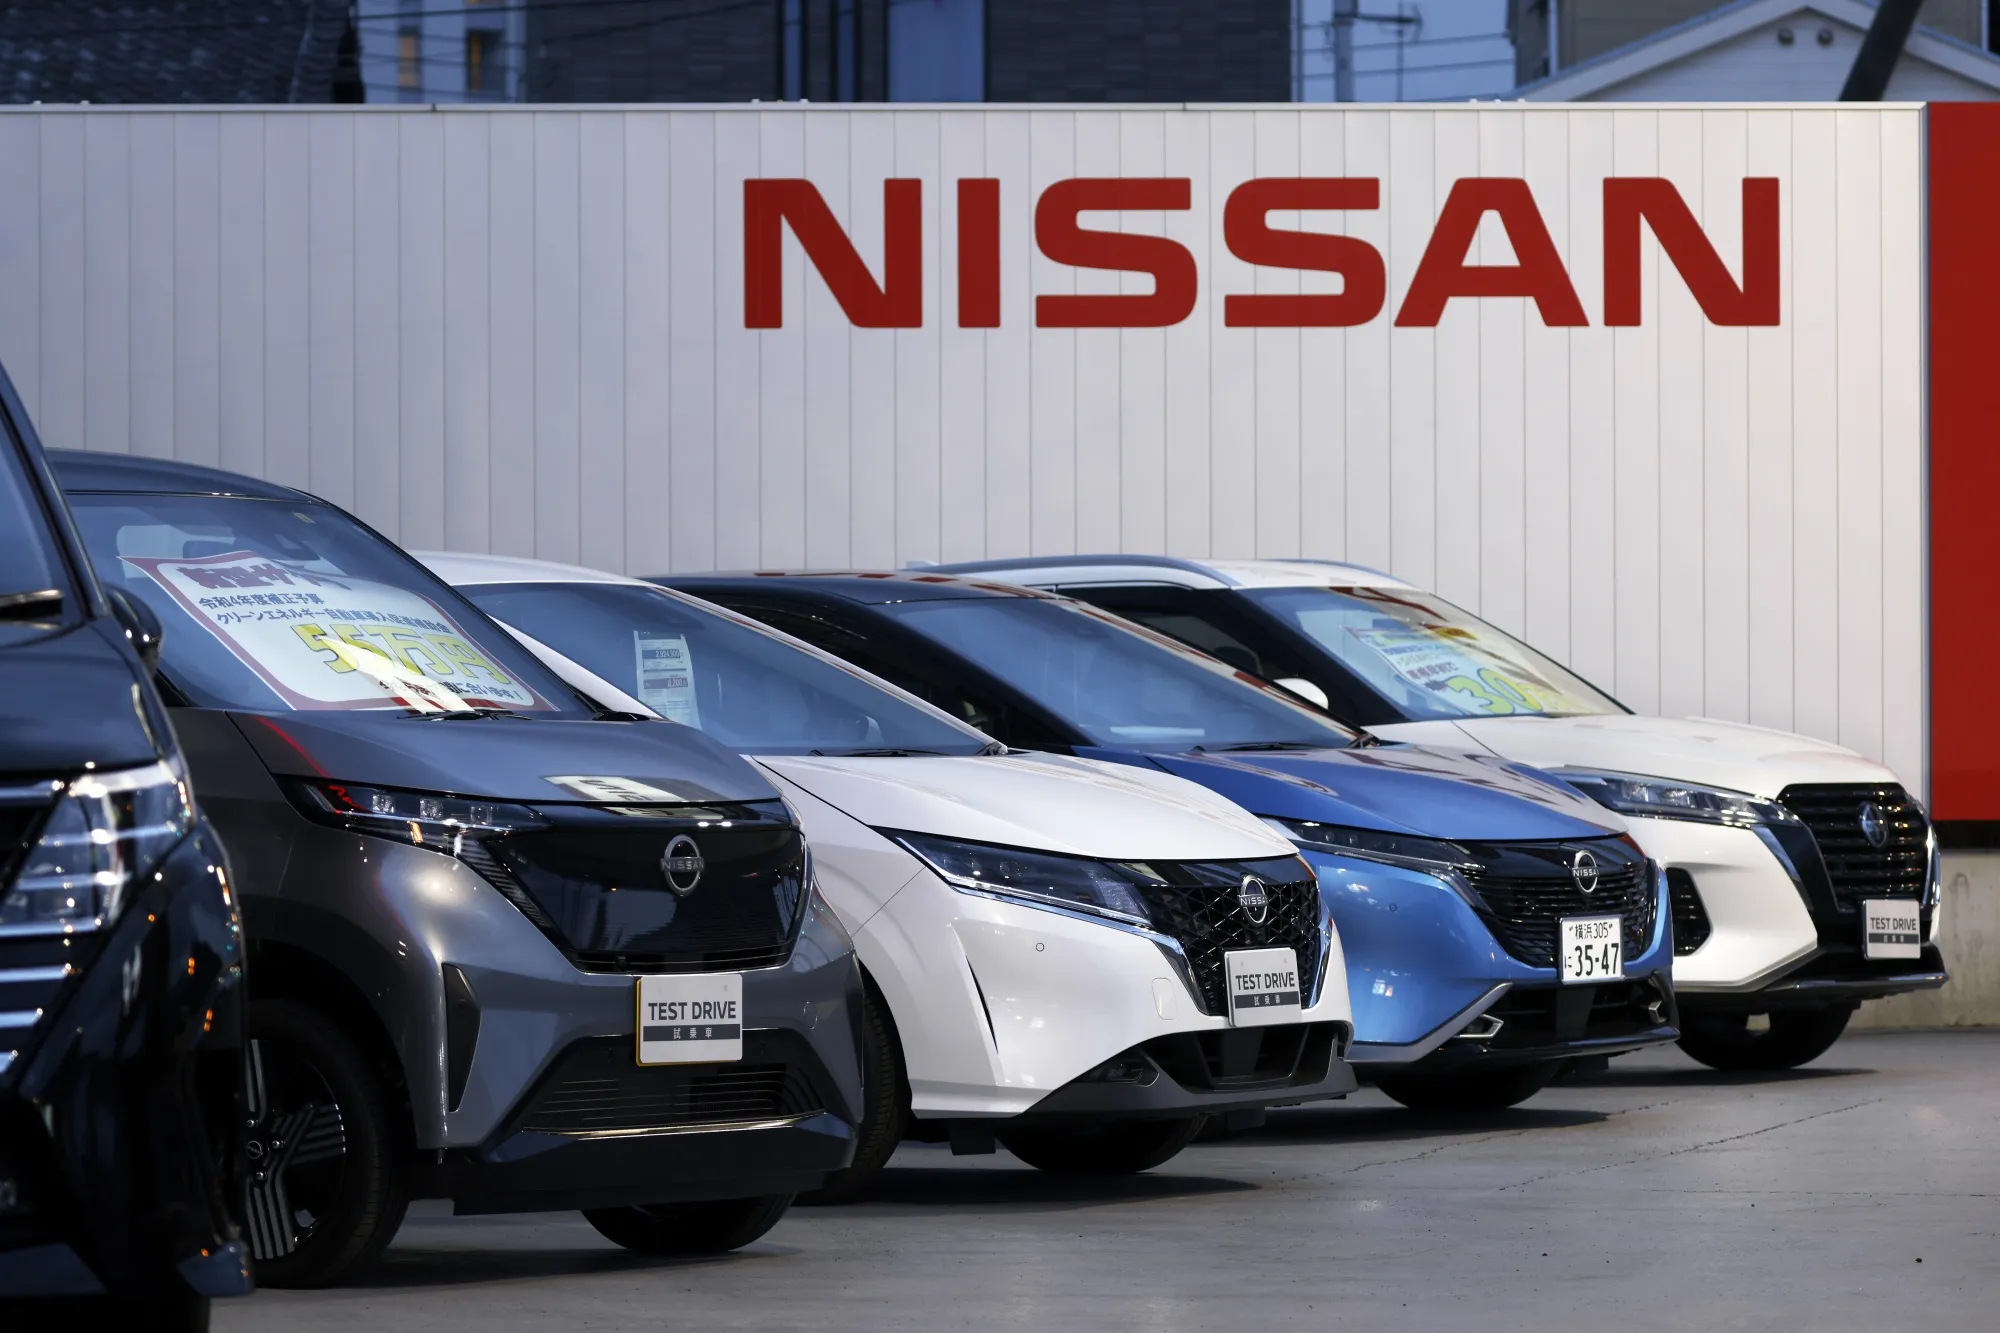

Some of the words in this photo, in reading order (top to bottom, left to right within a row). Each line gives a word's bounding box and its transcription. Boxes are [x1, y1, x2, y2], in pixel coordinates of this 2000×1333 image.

[744, 177, 1780, 329] NISSAN
[662, 859, 705, 871] NISSAN
[1870, 917, 1890, 930] TEST
[1892, 917, 1917, 931] DRIVE
[1235, 973, 1262, 991] TEST
[1264, 971, 1295, 989] DRIVE
[648, 1002, 688, 1021] TEST
[692, 1001, 737, 1020] DRIVE
[673, 1027, 713, 1040] 試乗車
